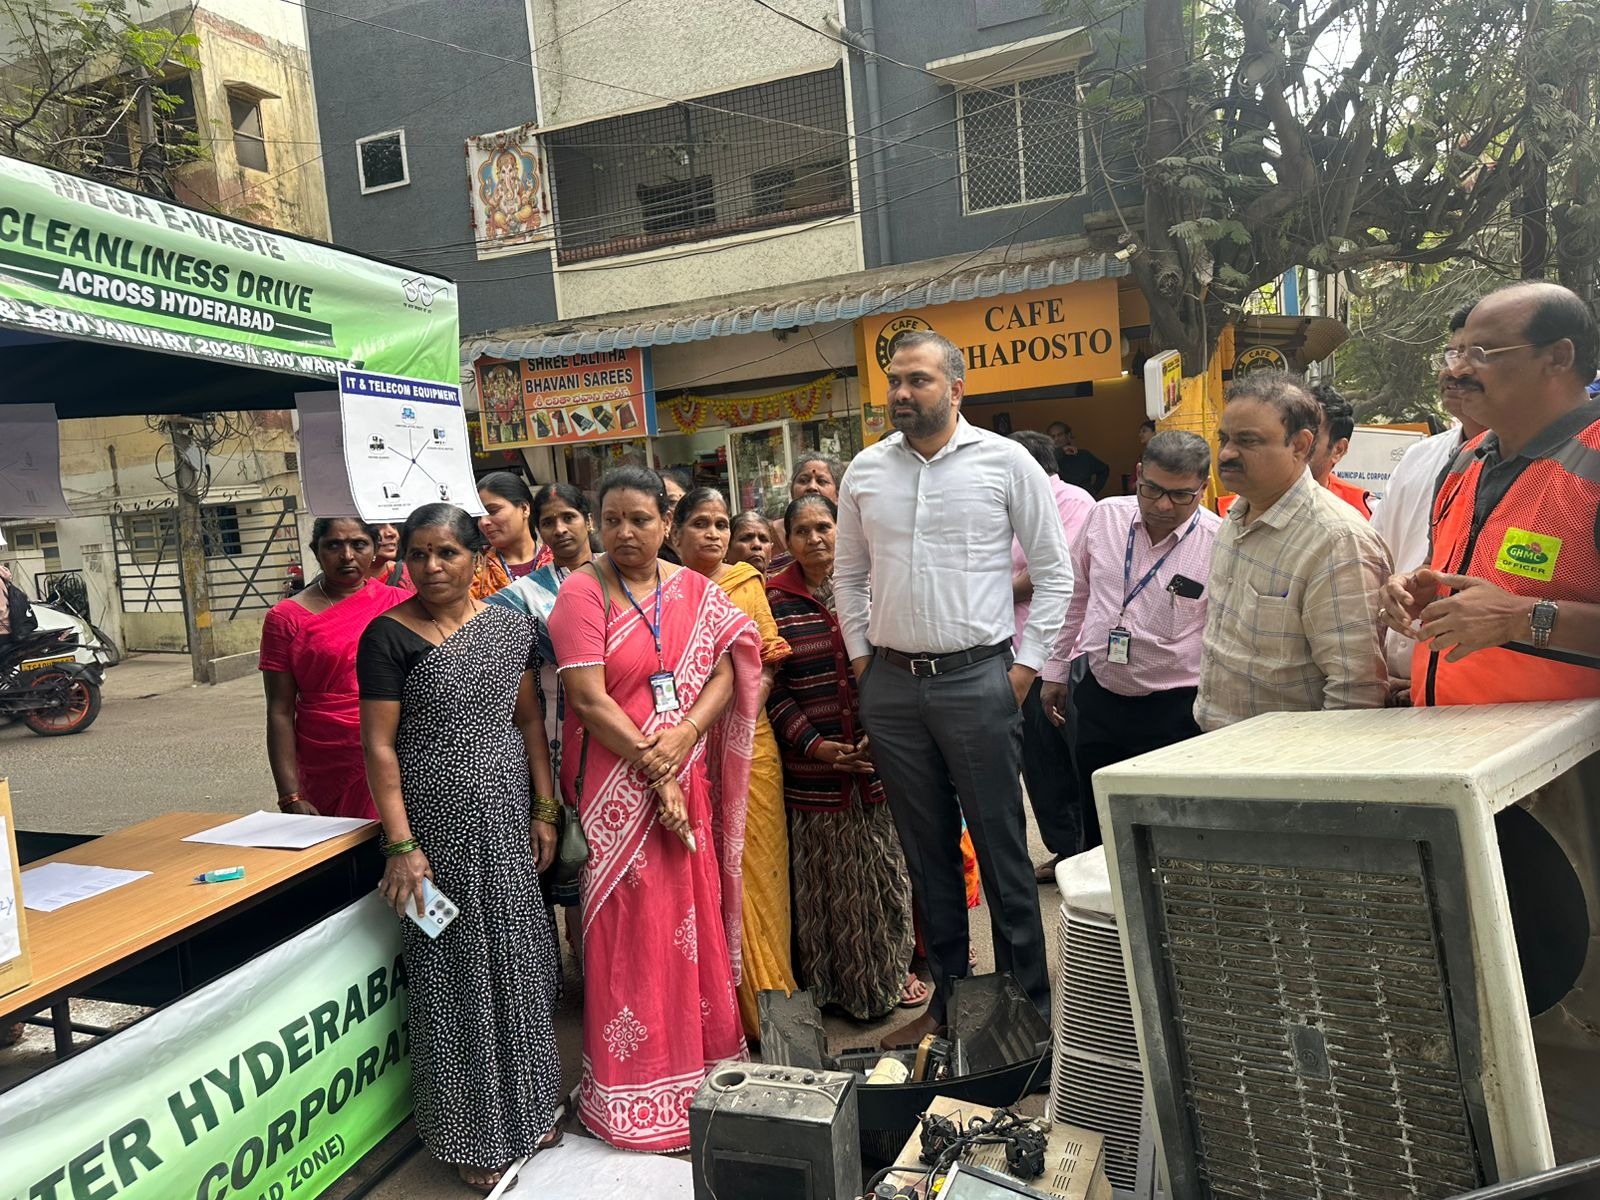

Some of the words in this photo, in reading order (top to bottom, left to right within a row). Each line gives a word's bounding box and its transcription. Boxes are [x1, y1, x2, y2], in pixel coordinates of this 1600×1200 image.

[158, 203, 285, 261] E-WASTE
[0, 206, 230, 293] CLEANLINESS
[237, 270, 313, 313] DRIVE
[58, 267, 155, 307] ACROSS
[160, 289, 274, 332] HYDERABAD
[891, 320, 918, 331] CAFE
[985, 298, 1065, 332] CAFE
[92, 318, 192, 353] JANUARY
[196, 340, 245, 359] 2026
[262, 350, 294, 368] 300
[960, 328, 1112, 371] HAPOSTO
[1249, 350, 1271, 358] CAFE
[528, 355, 568, 371] SHREE
[346, 376, 356, 389] IT
[360, 379, 366, 390] &
[368, 380, 411, 396] TELECOM
[413, 385, 457, 402] EQUIPMENT
[525, 375, 579, 393] BHAVANI
[584, 368, 632, 387] SAREES
[1337, 471, 1365, 480] MUNICIPAL
[1502, 559, 1546, 575] OFFICER
[1509, 547, 1541, 562] GHMC
[11, 1118, 164, 1200] TER
[287, 1133, 345, 1192] ZONE)
